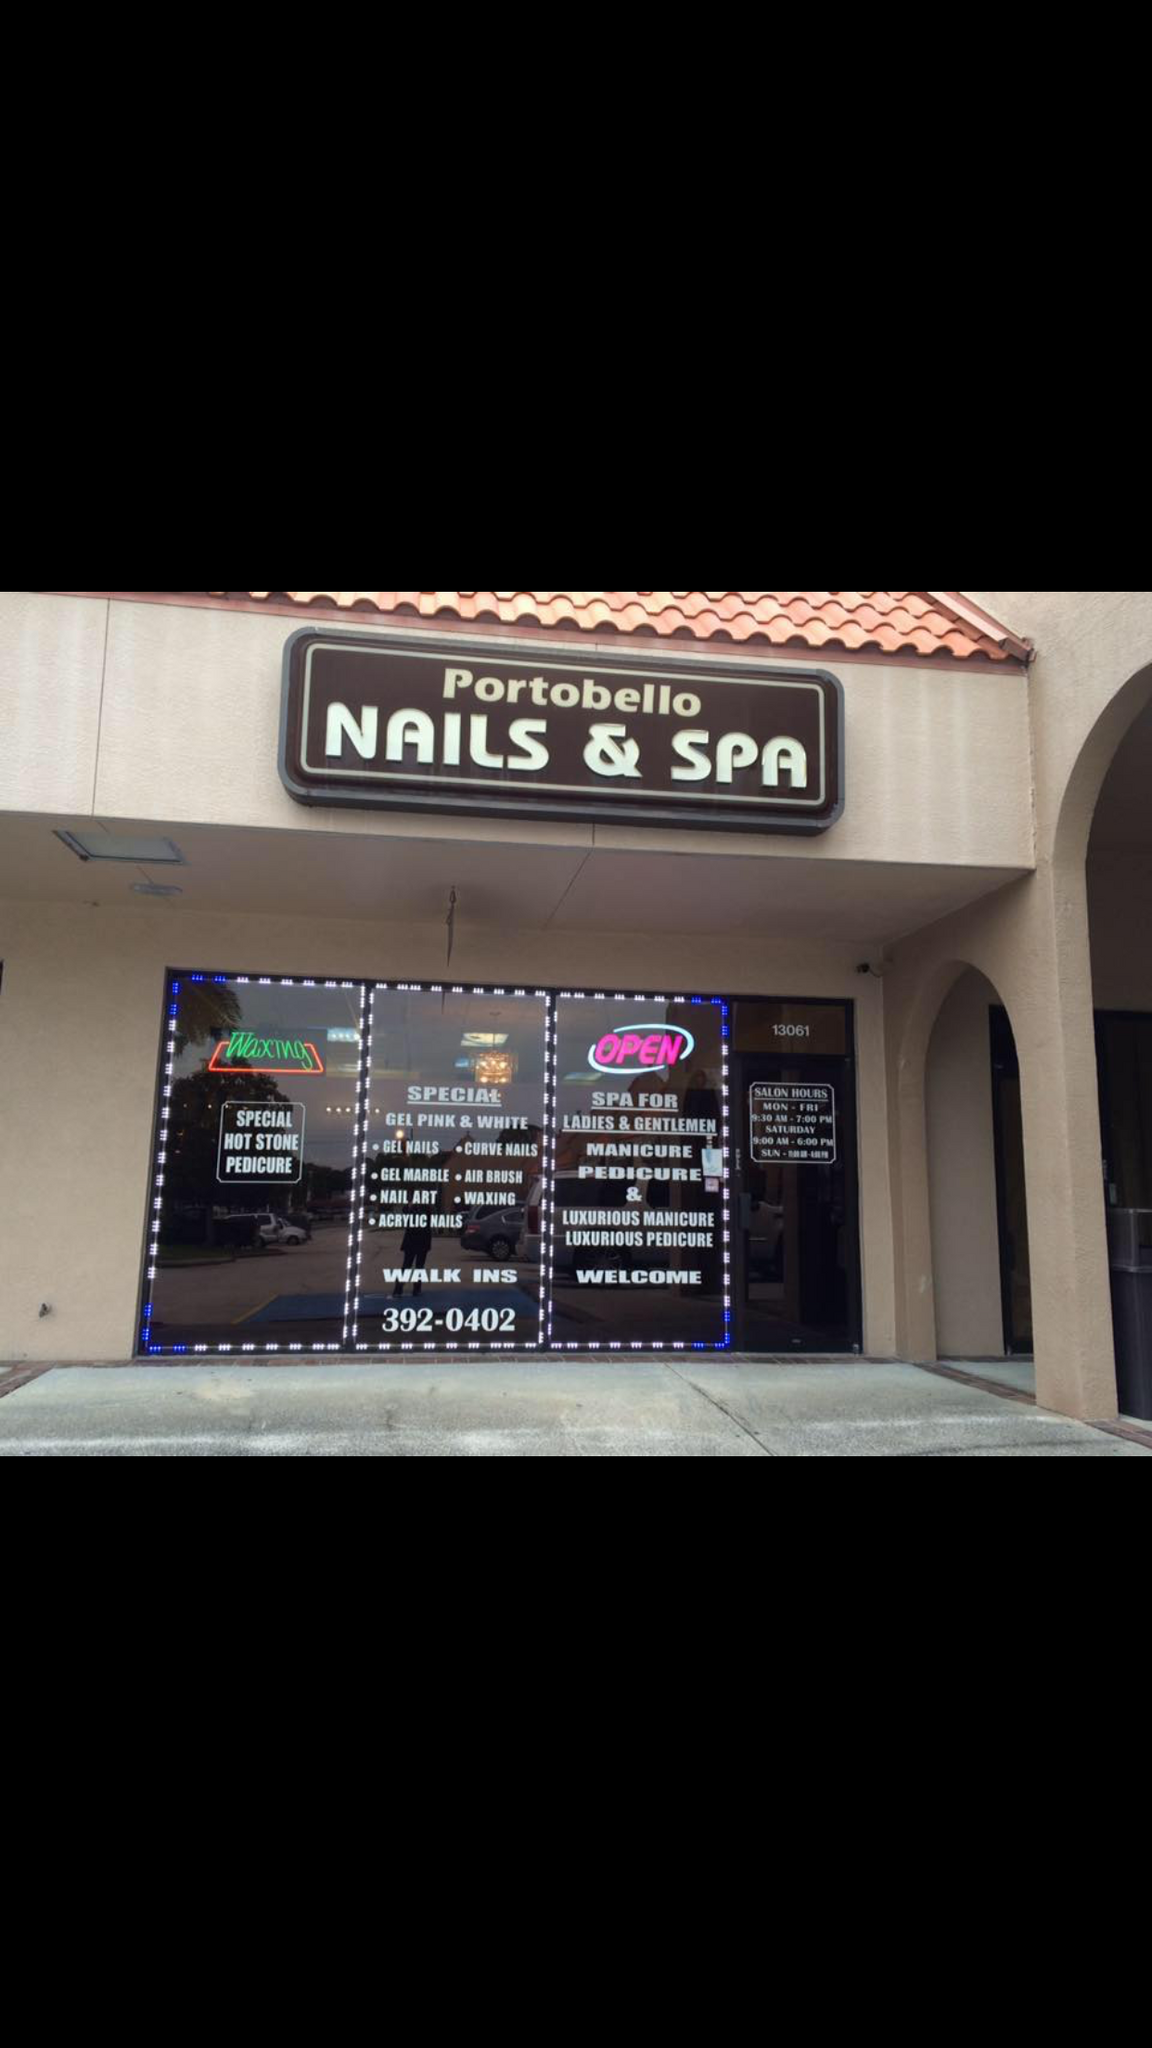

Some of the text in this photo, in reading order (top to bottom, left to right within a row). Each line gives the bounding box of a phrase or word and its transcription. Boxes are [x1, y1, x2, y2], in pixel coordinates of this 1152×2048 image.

[441, 667, 702, 717] Portobello
[325, 702, 807, 788] NAILS & SPA
[772, 1024, 810, 1037] 13061
[226, 1032, 313, 1071] Waxing
[595, 1033, 683, 1066] OPEN
[407, 1086, 501, 1103] SPECIAL
[755, 1087, 827, 1098] SALON HOURS
[592, 1092, 678, 1109] SPA FOR
[763, 1103, 788, 1111] MON
[800, 1103, 818, 1111] FRI
[236, 1110, 292, 1127] SPECIAL
[385, 1113, 528, 1130] GEL PINK & WHITE
[563, 1115, 716, 1133] LADIES & GENTLEMEN
[751, 1114, 772, 1122] 9:30
[796, 1115, 816, 1123] 7:00
[766, 1126, 815, 1134] SATURDAY
[224, 1133, 299, 1150] HOT STONE
[383, 1140, 439, 1155] GEL NAILS
[752, 1137, 773, 1145] 9:00
[464, 1142, 538, 1157] CURVE NAILS
[587, 1143, 693, 1158] MANICURE
[761, 1149, 780, 1157] SUN
[226, 1157, 292, 1173] PEDICURE
[381, 1168, 449, 1183] GEL MARBLE
[464, 1169, 523, 1184] AIR BRUSH
[578, 1166, 702, 1181] PEDICURE
[380, 1190, 437, 1204] NAIL ART
[464, 1192, 515, 1206] WAXING
[626, 1187, 642, 1202] &
[378, 1214, 463, 1228] ACRYLIC NAILS
[563, 1210, 714, 1227] LUXURIOUS MANICURE
[565, 1231, 713, 1247] LUXURIOUS PEDICURE
[383, 1269, 517, 1283] WALK INS
[576, 1270, 702, 1284] WELCOME
[382, 1308, 516, 1332] 392-0402
